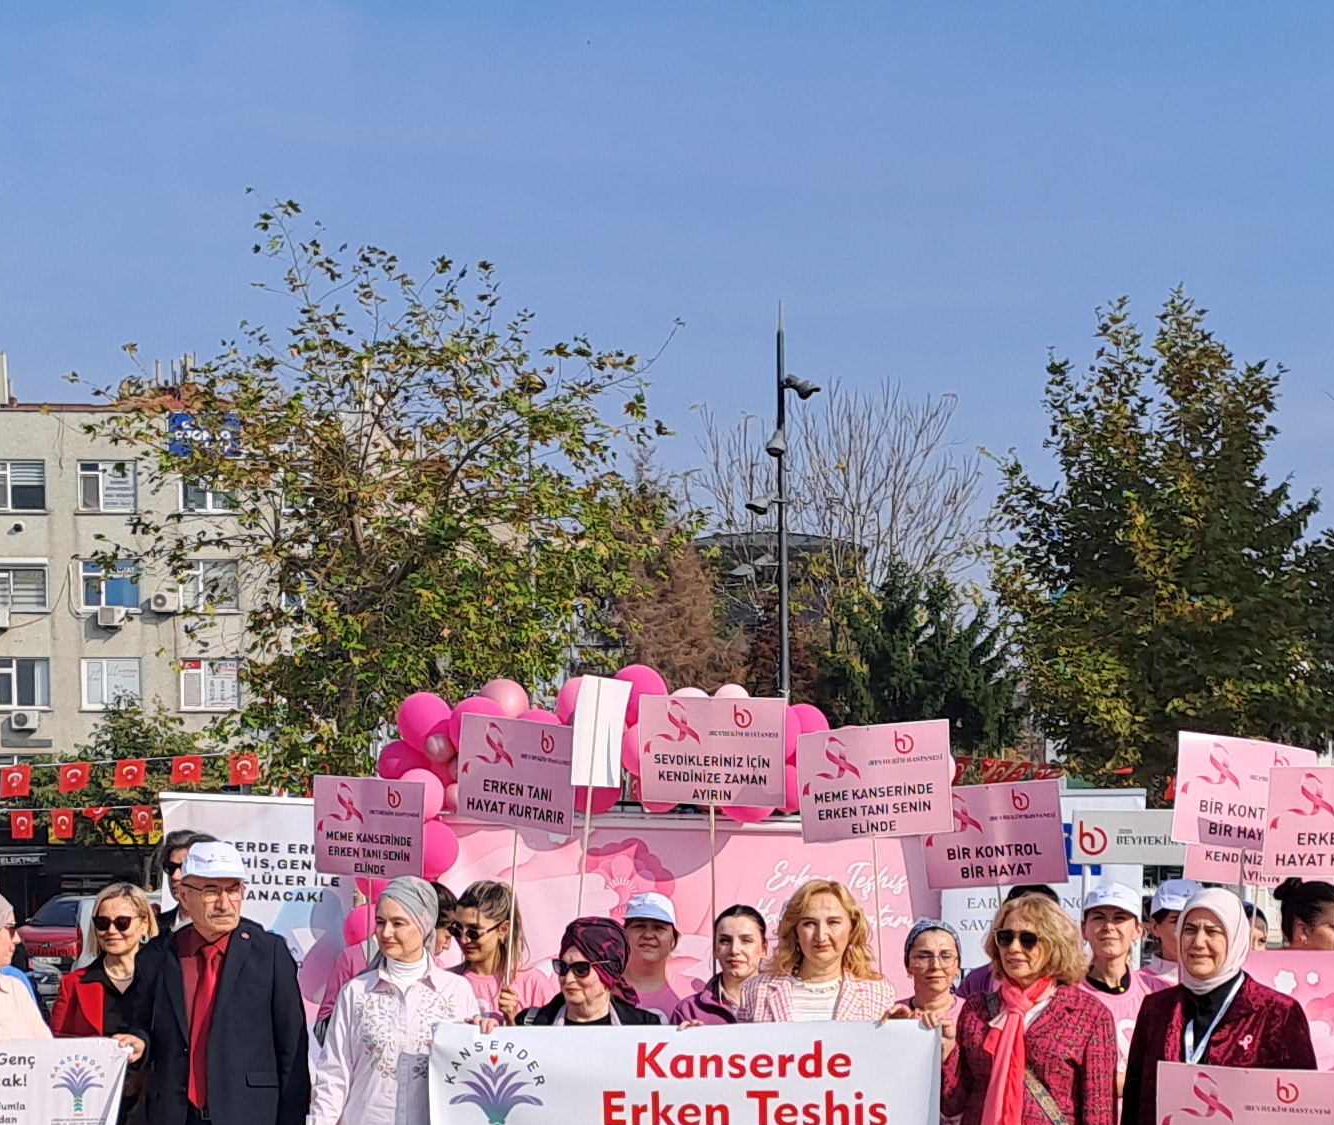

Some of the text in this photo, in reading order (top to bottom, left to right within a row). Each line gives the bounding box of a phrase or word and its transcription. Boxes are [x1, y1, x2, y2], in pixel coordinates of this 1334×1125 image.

[654, 752, 771, 772] SEVDİKLERİNİZ İÇİN
[658, 768, 768, 786] KENDİNİZE ZAMAN
[483, 778, 553, 803] ERKEN TANI
[692, 786, 732, 801] AYIRIN
[814, 781, 934, 804] MEME KANSERİNDE
[467, 797, 566, 826] HAYAT KURTARIR
[817, 797, 932, 821] ERKEN TANI SENİN
[1199, 797, 1266, 821] BİR KONT
[851, 817, 897, 834] ELİNDE
[1208, 820, 1264, 841] BİR HAY
[225, 841, 280, 854] ERDE
[325, 830, 413, 848] MEME KANSERİNDE
[328, 846, 411, 862] ERKEN TANI SENİN
[946, 843, 1042, 861] BİR KONTROL
[1205, 851, 1264, 866] KENDNİZ
[1275, 850, 1327, 868] HAYAT
[353, 863, 386, 875] ELİNDE
[960, 863, 1033, 879] BİR HAYAT
[246, 890, 324, 903] ANACAK!
[444, 1039, 546, 1087] KANSERDER
[635, 1040, 853, 1080] Kanserde
